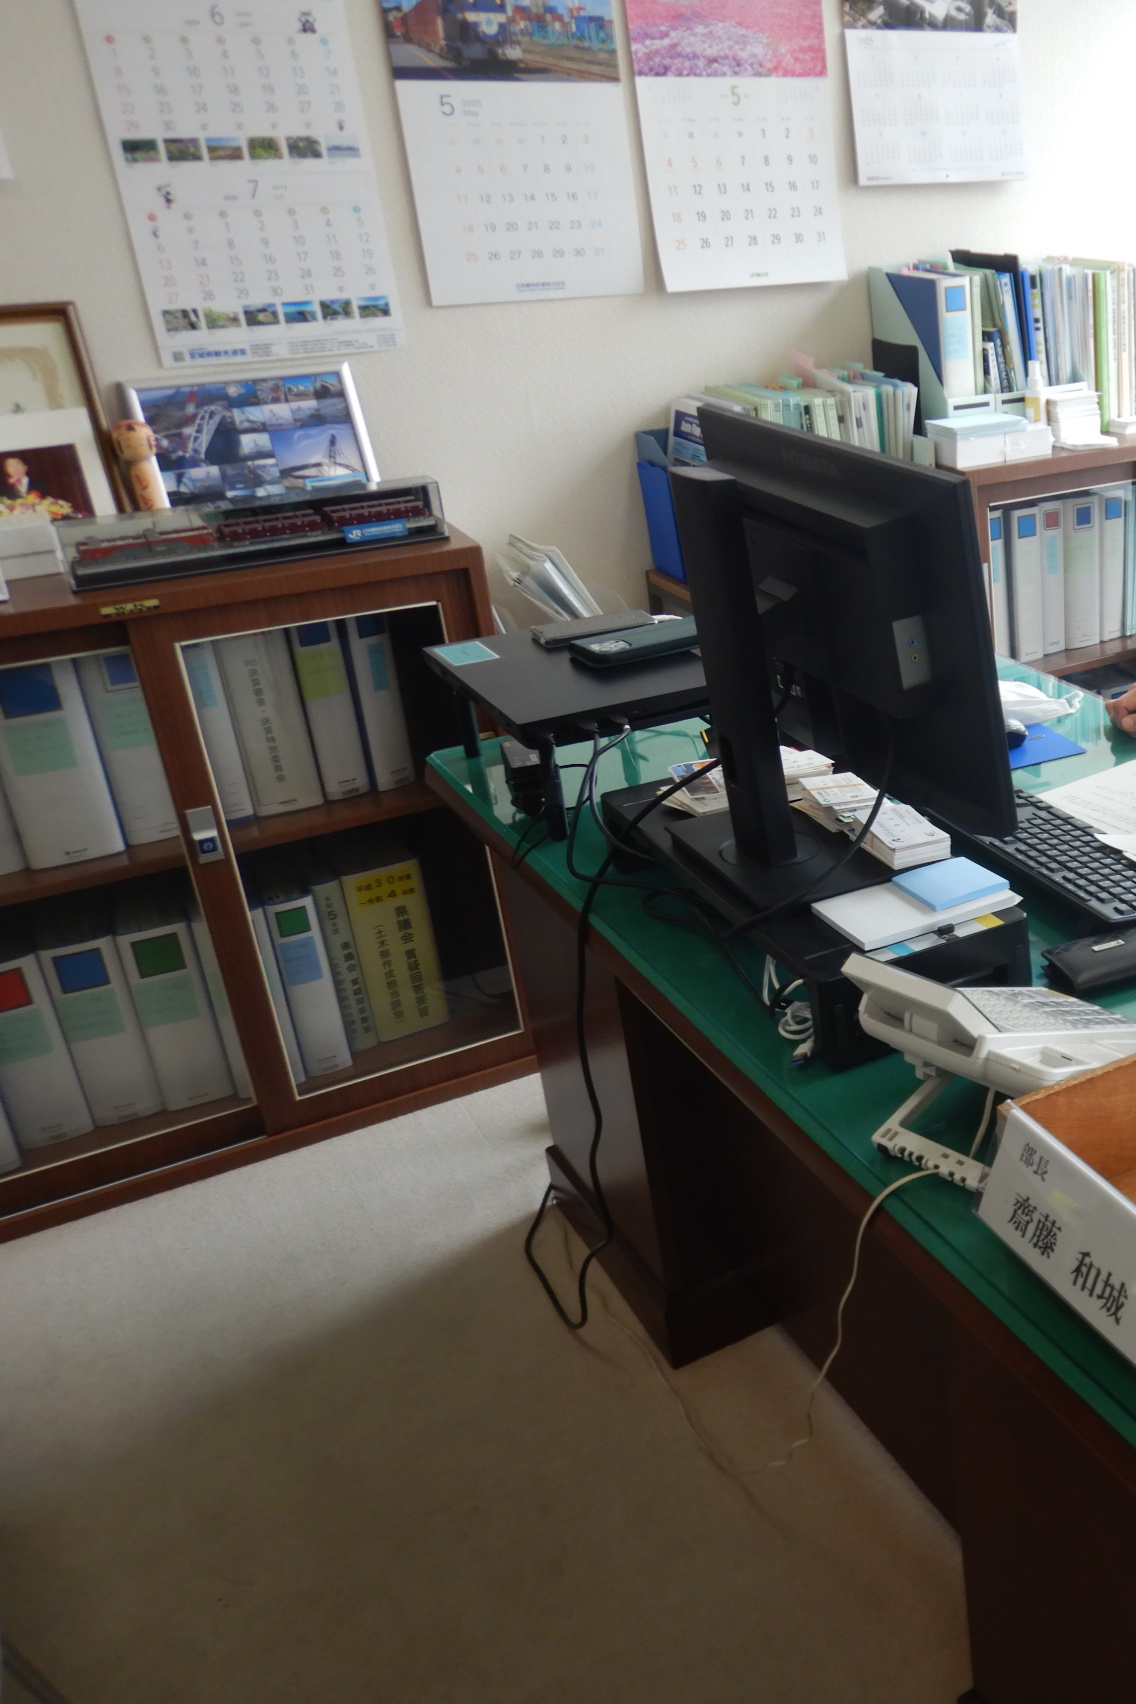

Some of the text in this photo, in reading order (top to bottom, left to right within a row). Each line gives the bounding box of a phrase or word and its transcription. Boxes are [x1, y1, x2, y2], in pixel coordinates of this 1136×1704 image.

[210, 4, 225, 26] 6
[186, 65, 200, 78] 10
[222, 66, 235, 77] 11
[256, 66, 270, 79] 12
[291, 66, 305, 78] 13
[326, 66, 338, 78] 14
[154, 84, 168, 96] 16
[190, 83, 203, 96] 17
[226, 83, 240, 96] 18
[261, 83, 275, 95] 19
[295, 83, 308, 96] 20
[328, 83, 341, 95] 21
[731, 85, 740, 106] 5
[156, 101, 173, 114] 23
[194, 101, 208, 113] 24
[230, 101, 244, 113] 25
[265, 101, 278, 113] 26
[298, 100, 311, 114] 27
[332, 100, 346, 113] 28
[440, 94, 455, 116] 5
[163, 120, 176, 132] 30
[540, 135, 545, 144] 1
[562, 134, 567, 144] 2
[761, 128, 814, 139] 1 2 3
[691, 157, 698, 168] 5
[716, 157, 722, 167] 6
[740, 155, 745, 166] 7
[764, 155, 770, 166] 8
[787, 154, 793, 165] 9
[808, 154, 818, 165] 10
[477, 165, 485, 174] 5
[499, 164, 507, 174] 6
[522, 164, 528, 173] 7
[544, 164, 550, 173] 8
[565, 163, 572, 173] 9
[246, 180, 259, 199] 7
[693, 184, 702, 195] 12
[717, 183, 727, 194] 13
[741, 182, 750, 193] 14
[765, 181, 774, 192] 15
[788, 181, 798, 191] 16
[811, 180, 820, 190] 17
[480, 194, 491, 204] 12
[502, 193, 514, 203] 13
[524, 193, 536, 202] 14
[545, 192, 557, 202] 15
[567, 192, 578, 201] 16
[696, 211, 706, 222] 19
[720, 210, 731, 221] 20
[744, 209, 754, 220] 21
[768, 208, 777, 219] 22
[790, 206, 800, 218] 23
[814, 206, 822, 216] 24
[484, 223, 496, 232] 19
[506, 222, 518, 232] 20
[527, 221, 538, 231] 21
[548, 221, 560, 230] 22
[570, 220, 582, 229] 23
[292, 235, 306, 246] 10
[326, 234, 337, 244] 11
[358, 232, 369, 243] 12
[700, 238, 711, 249] 26
[724, 236, 734, 247] 27
[748, 235, 758, 246] 28
[771, 234, 781, 244] 29
[794, 232, 804, 243] 30
[816, 232, 826, 242] 31
[194, 257, 207, 268] 14
[229, 255, 242, 266] 15
[263, 254, 276, 264] 16
[296, 251, 308, 262] 17
[329, 250, 342, 261] 18
[361, 248, 373, 260] 19
[488, 251, 500, 260] 26
[510, 250, 522, 260] 27
[531, 249, 544, 259] 28
[552, 248, 564, 258] 29
[573, 248, 585, 257] 30
[197, 274, 210, 286] 21
[232, 271, 245, 283] 22
[266, 270, 280, 281] 23
[300, 268, 312, 279] 24
[332, 266, 345, 277] 25
[364, 264, 377, 275] 26
[201, 290, 215, 301] 28
[236, 287, 249, 299] 29
[270, 286, 283, 297] 30
[302, 284, 314, 296] 31
[348, 529, 362, 538] JR
[1019, 1141, 1050, 1183] 部長
[1007, 1192, 1129, 1326] 齋藤 和城
